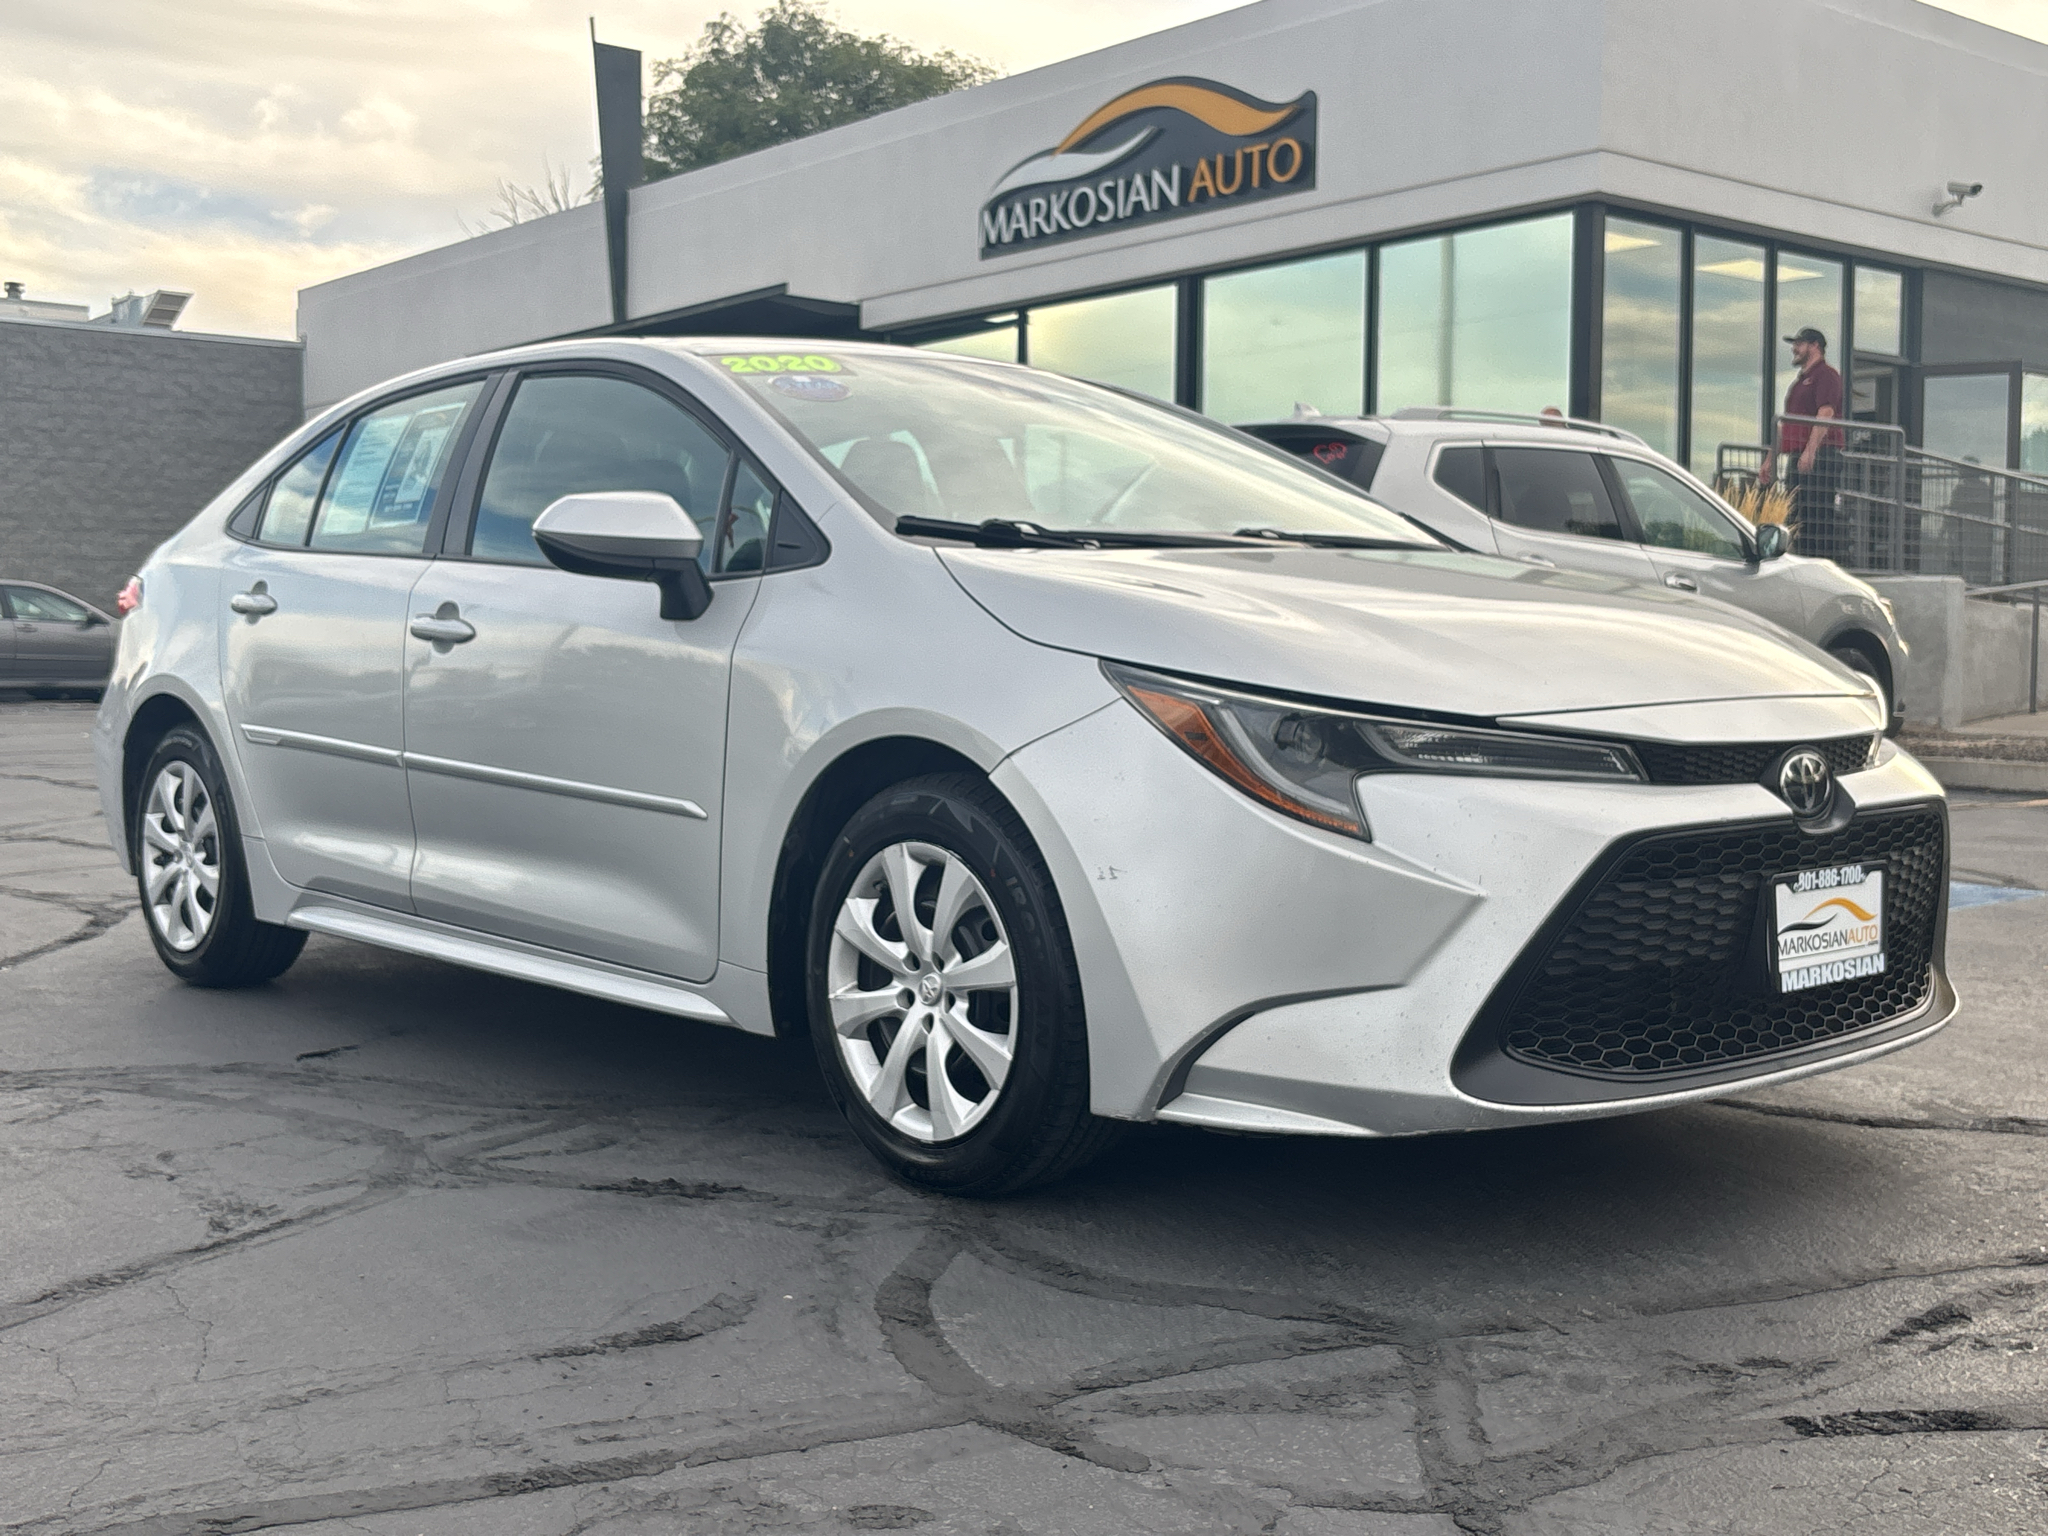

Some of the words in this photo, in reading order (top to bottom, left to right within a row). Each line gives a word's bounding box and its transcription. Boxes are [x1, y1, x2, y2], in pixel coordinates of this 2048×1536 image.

[982, 163, 1181, 244] MARKOSIAN
[1187, 137, 1302, 202] AUTO
[721, 354, 842, 373] 2020
[1781, 952, 1885, 993] MARKOSIAN
